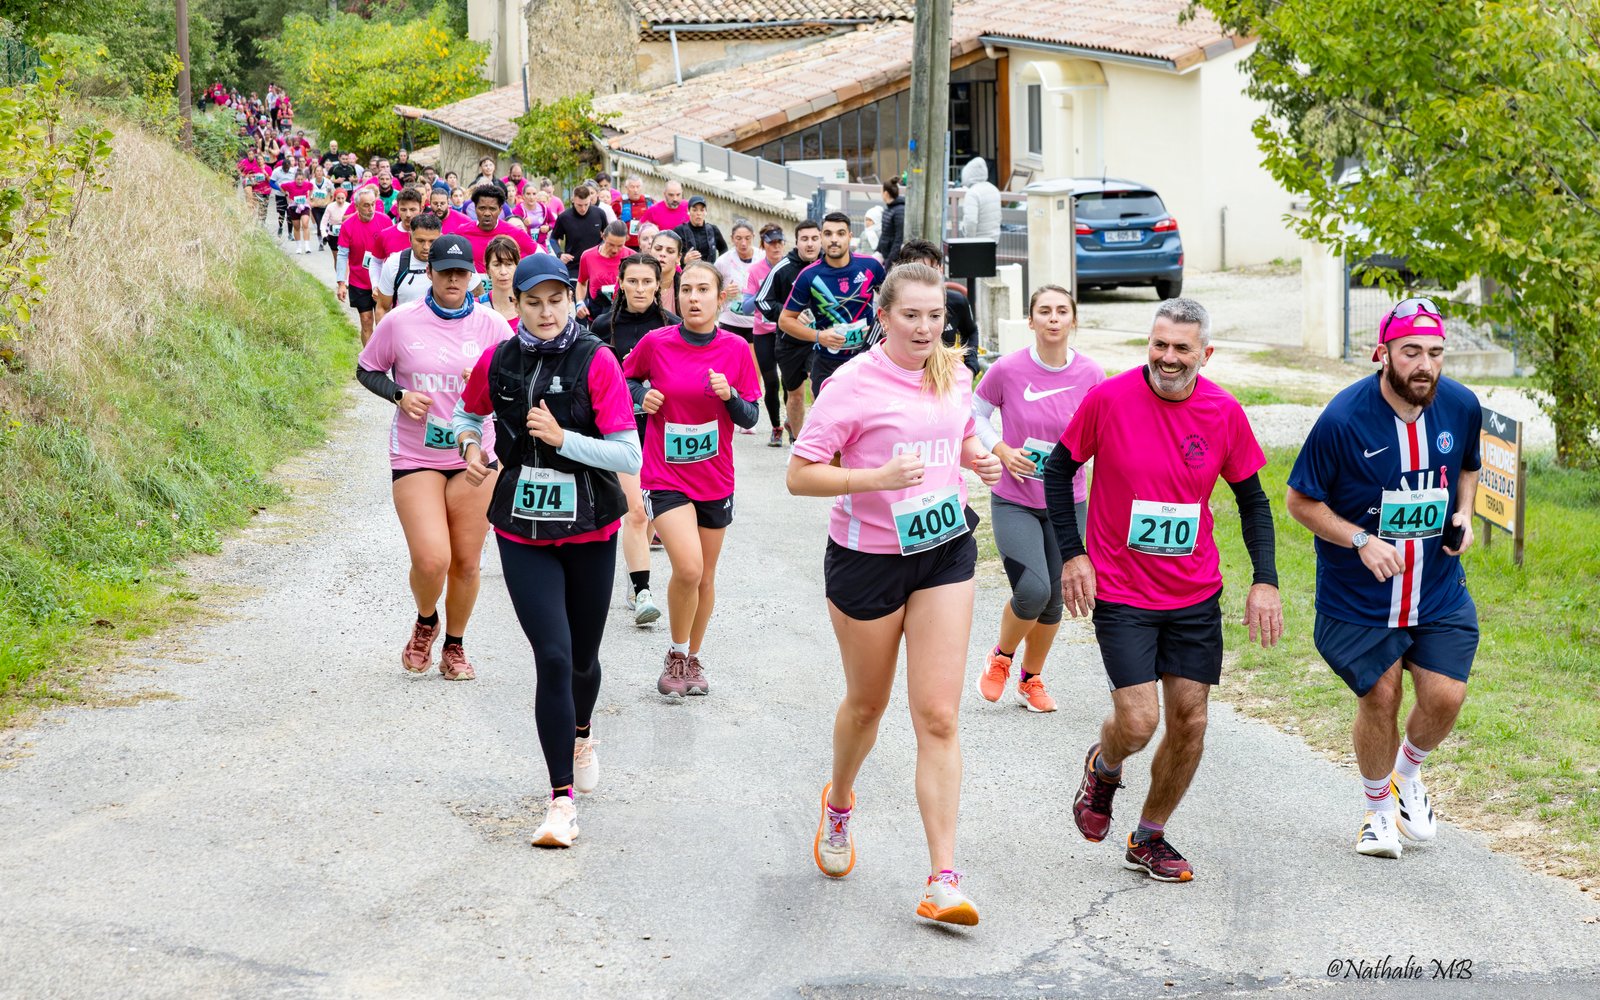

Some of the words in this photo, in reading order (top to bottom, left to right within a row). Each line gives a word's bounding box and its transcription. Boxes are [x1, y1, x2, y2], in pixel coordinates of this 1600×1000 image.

[672, 434, 713, 455] 194
[1485, 440, 1516, 475] VENDRE
[522, 483, 562, 510] 574
[1485, 493, 1505, 517] TERRAIN
[908, 502, 956, 539] 400
[1389, 504, 1438, 529] 440
[1138, 518, 1190, 545] 210
